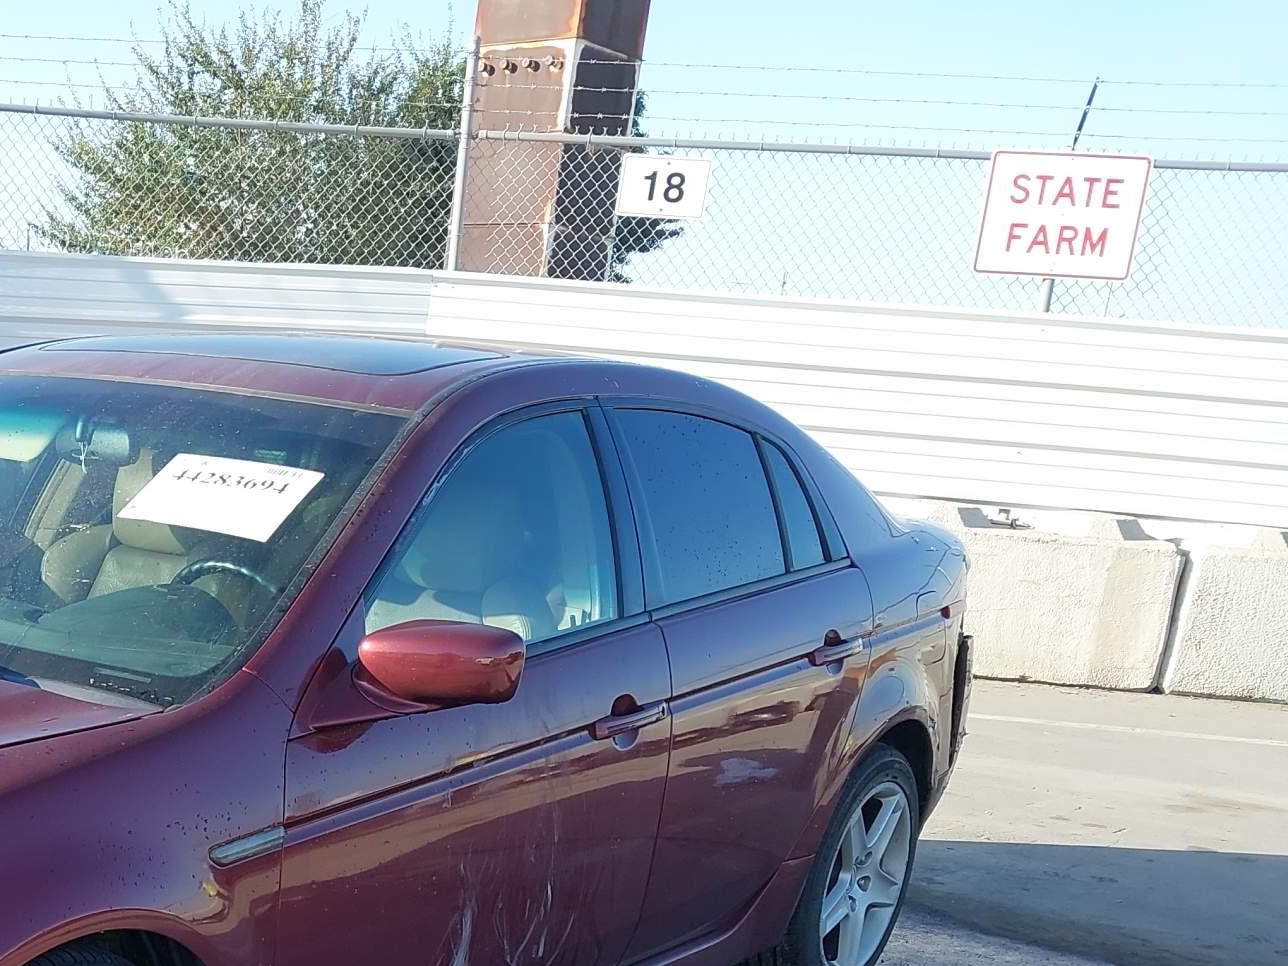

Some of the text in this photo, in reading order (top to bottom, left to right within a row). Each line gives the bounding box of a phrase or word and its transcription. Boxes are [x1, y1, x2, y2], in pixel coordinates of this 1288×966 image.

[643, 170, 686, 203] 18
[1009, 174, 1125, 209] STATE
[1005, 223, 1110, 257] FARM
[172, 469, 290, 494] 44283694
